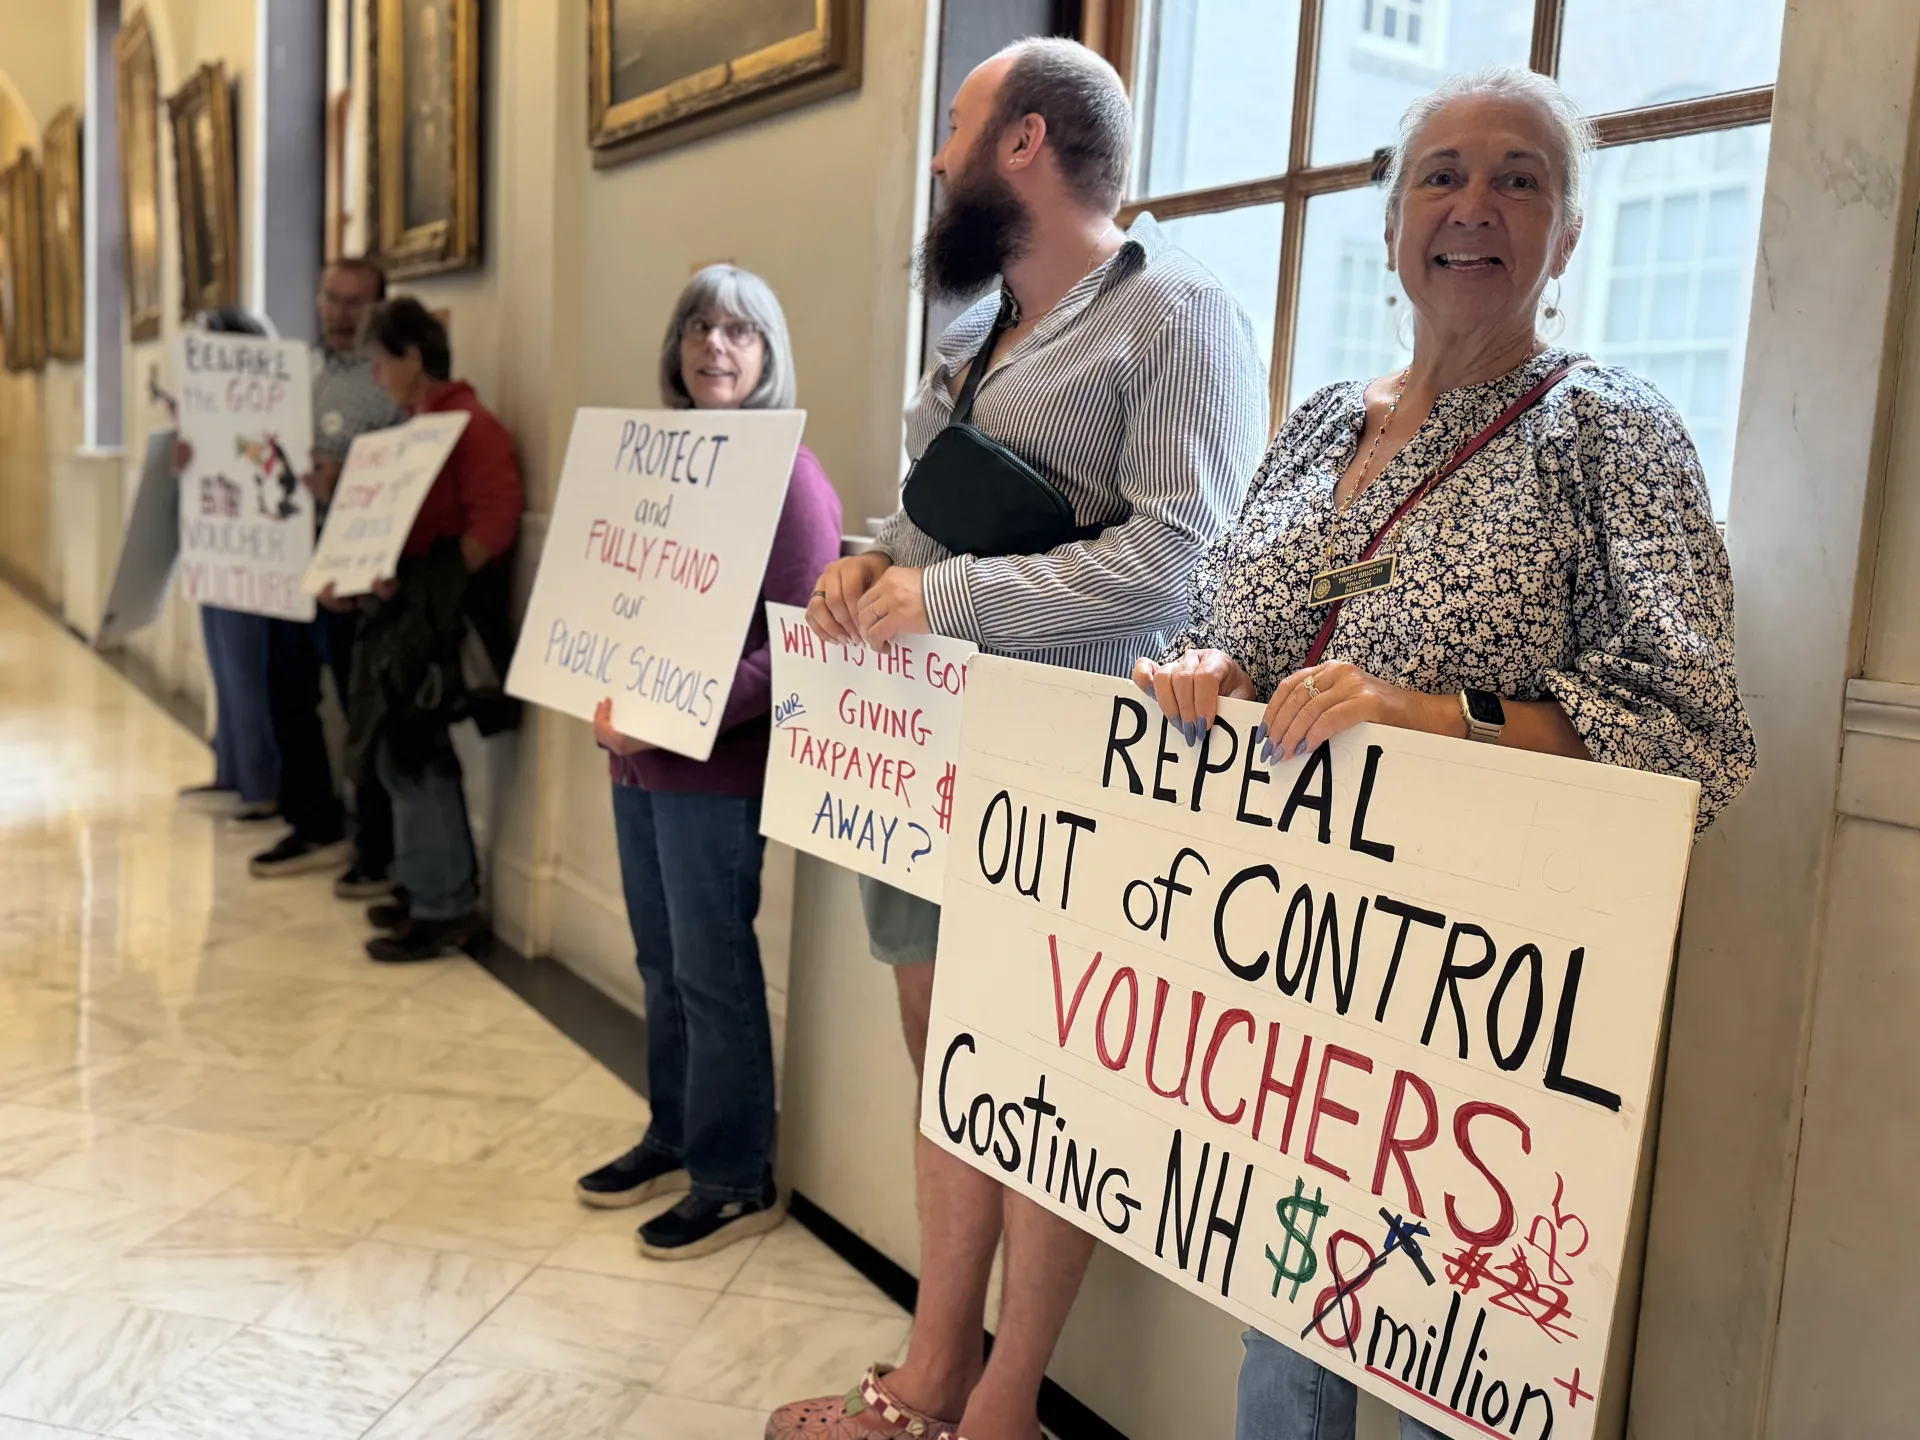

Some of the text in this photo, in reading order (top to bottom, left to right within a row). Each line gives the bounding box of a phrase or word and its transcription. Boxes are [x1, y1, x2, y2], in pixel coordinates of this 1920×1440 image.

[184, 338, 290, 380] BEWARE
[225, 378, 285, 414] GOP
[614, 419, 729, 488] PROTECT
[182, 519, 287, 563] VOUCHER
[634, 494, 673, 529] and
[585, 519, 720, 595] FULLY FUND
[612, 592, 646, 620] our
[545, 617, 719, 728] PUBLIC SCHOOLS
[774, 692, 804, 721] OUR
[839, 688, 933, 746] GIVING
[781, 726, 916, 808] TAXPAYER
[1102, 695, 1395, 862] REPEAL
[977, 789, 1622, 1112] OUT of CONTROL
[1048, 933, 1532, 1248] VOUCHERS
[1155, 1129, 1254, 1297] NH
